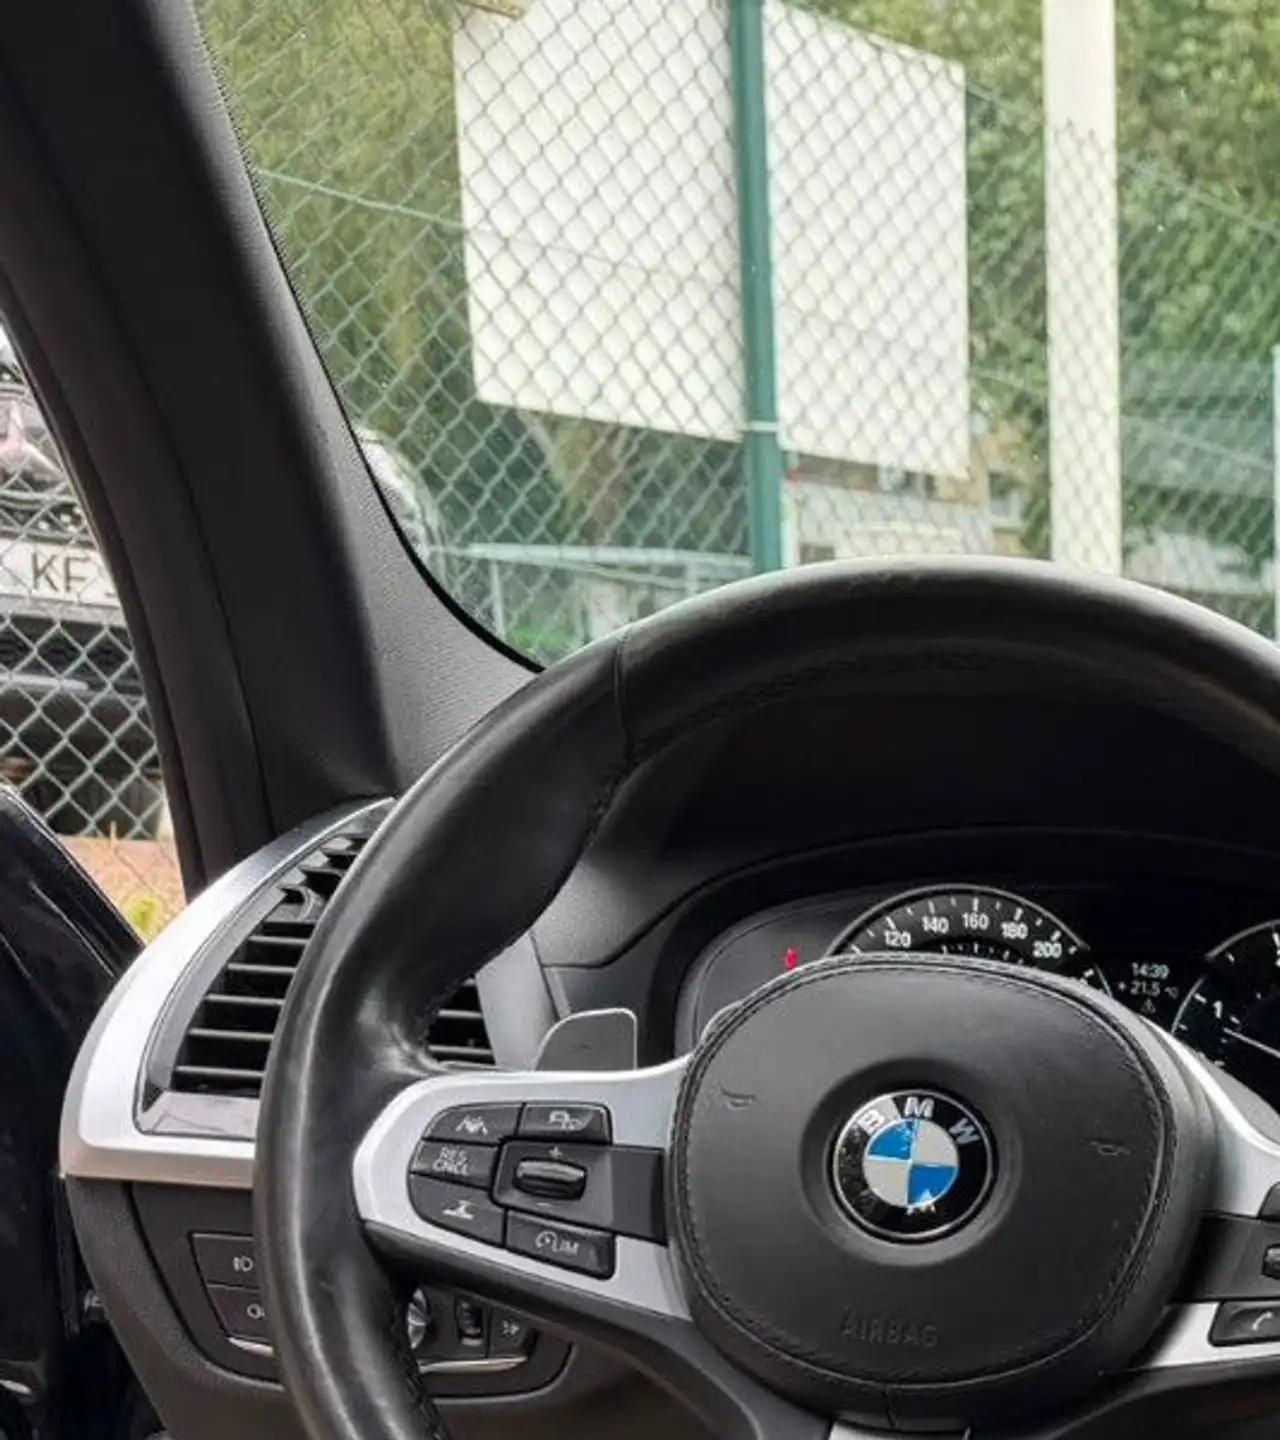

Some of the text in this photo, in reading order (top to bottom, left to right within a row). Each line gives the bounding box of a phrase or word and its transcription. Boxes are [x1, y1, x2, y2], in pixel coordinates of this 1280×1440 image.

[922, 915, 949, 934] 140
[962, 912, 989, 929] 160
[1000, 921, 1028, 939] 180
[884, 929, 911, 948] 120
[1032, 940, 1062, 959] 200
[1131, 962, 1170, 979] 14:39
[1212, 1000, 1223, 1019] 1
[855, 1096, 981, 1145] BMW
[841, 1308, 939, 1347] AIRBAG
